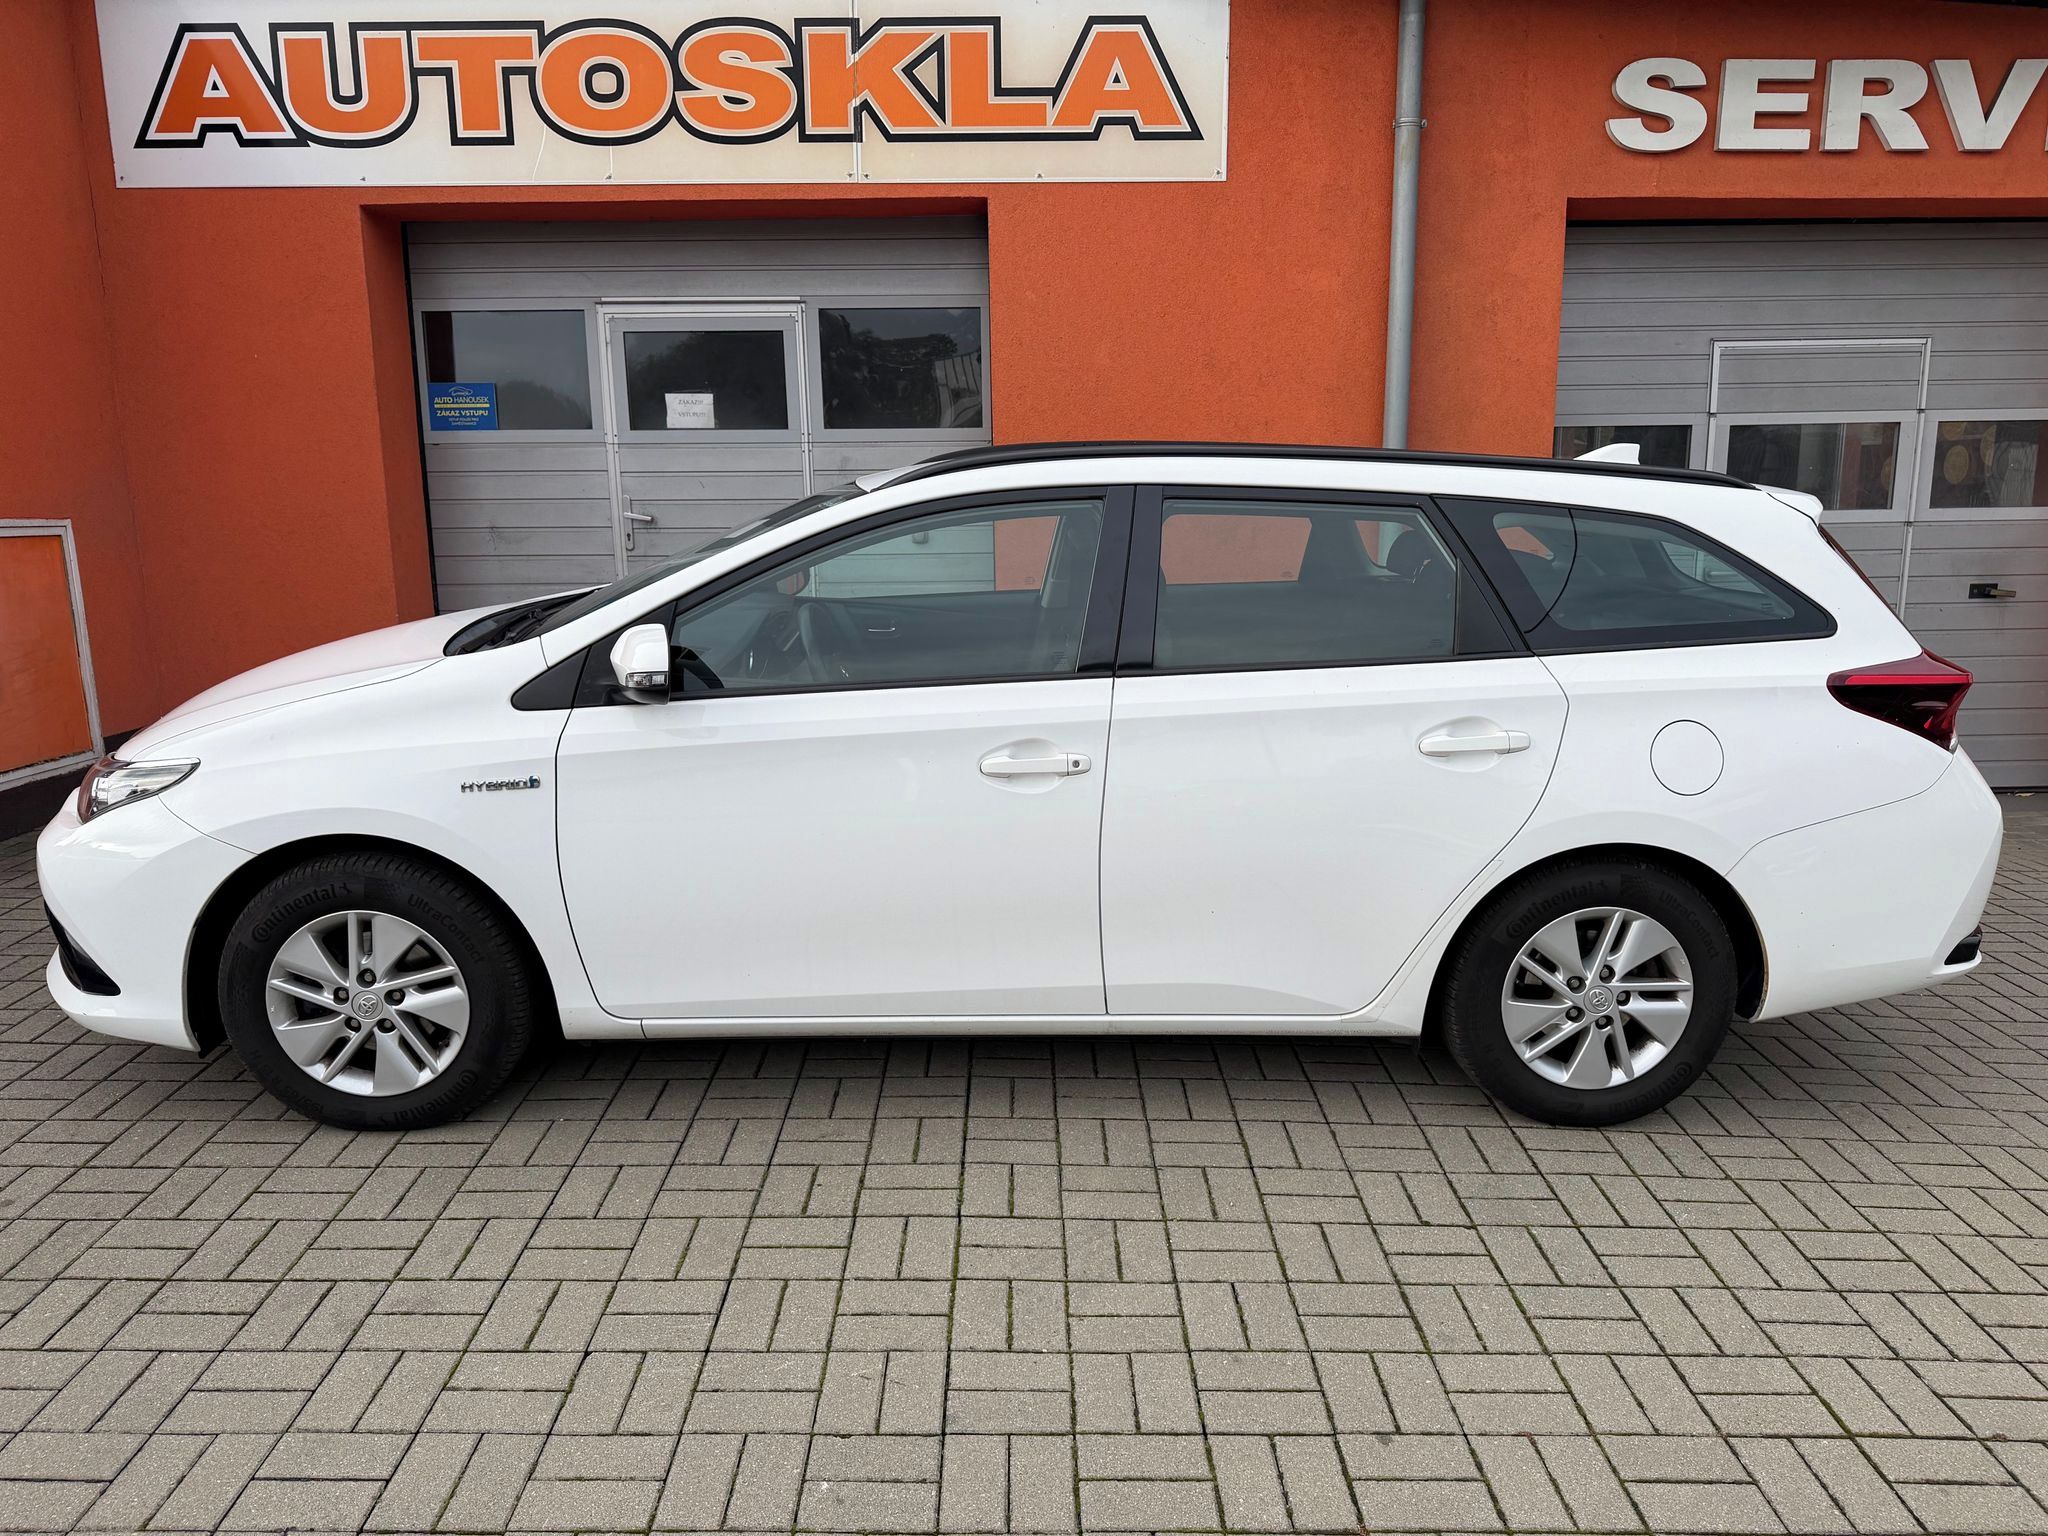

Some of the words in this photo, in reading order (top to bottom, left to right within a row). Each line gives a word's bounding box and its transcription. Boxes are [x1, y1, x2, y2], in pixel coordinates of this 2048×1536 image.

[136, 15, 1204, 148] AUTOSKLA
[1605, 57, 2048, 154] SERV
[461, 779, 528, 793] HYBRID
[251, 883, 338, 944] Continental
[407, 893, 487, 965] UltraContact
